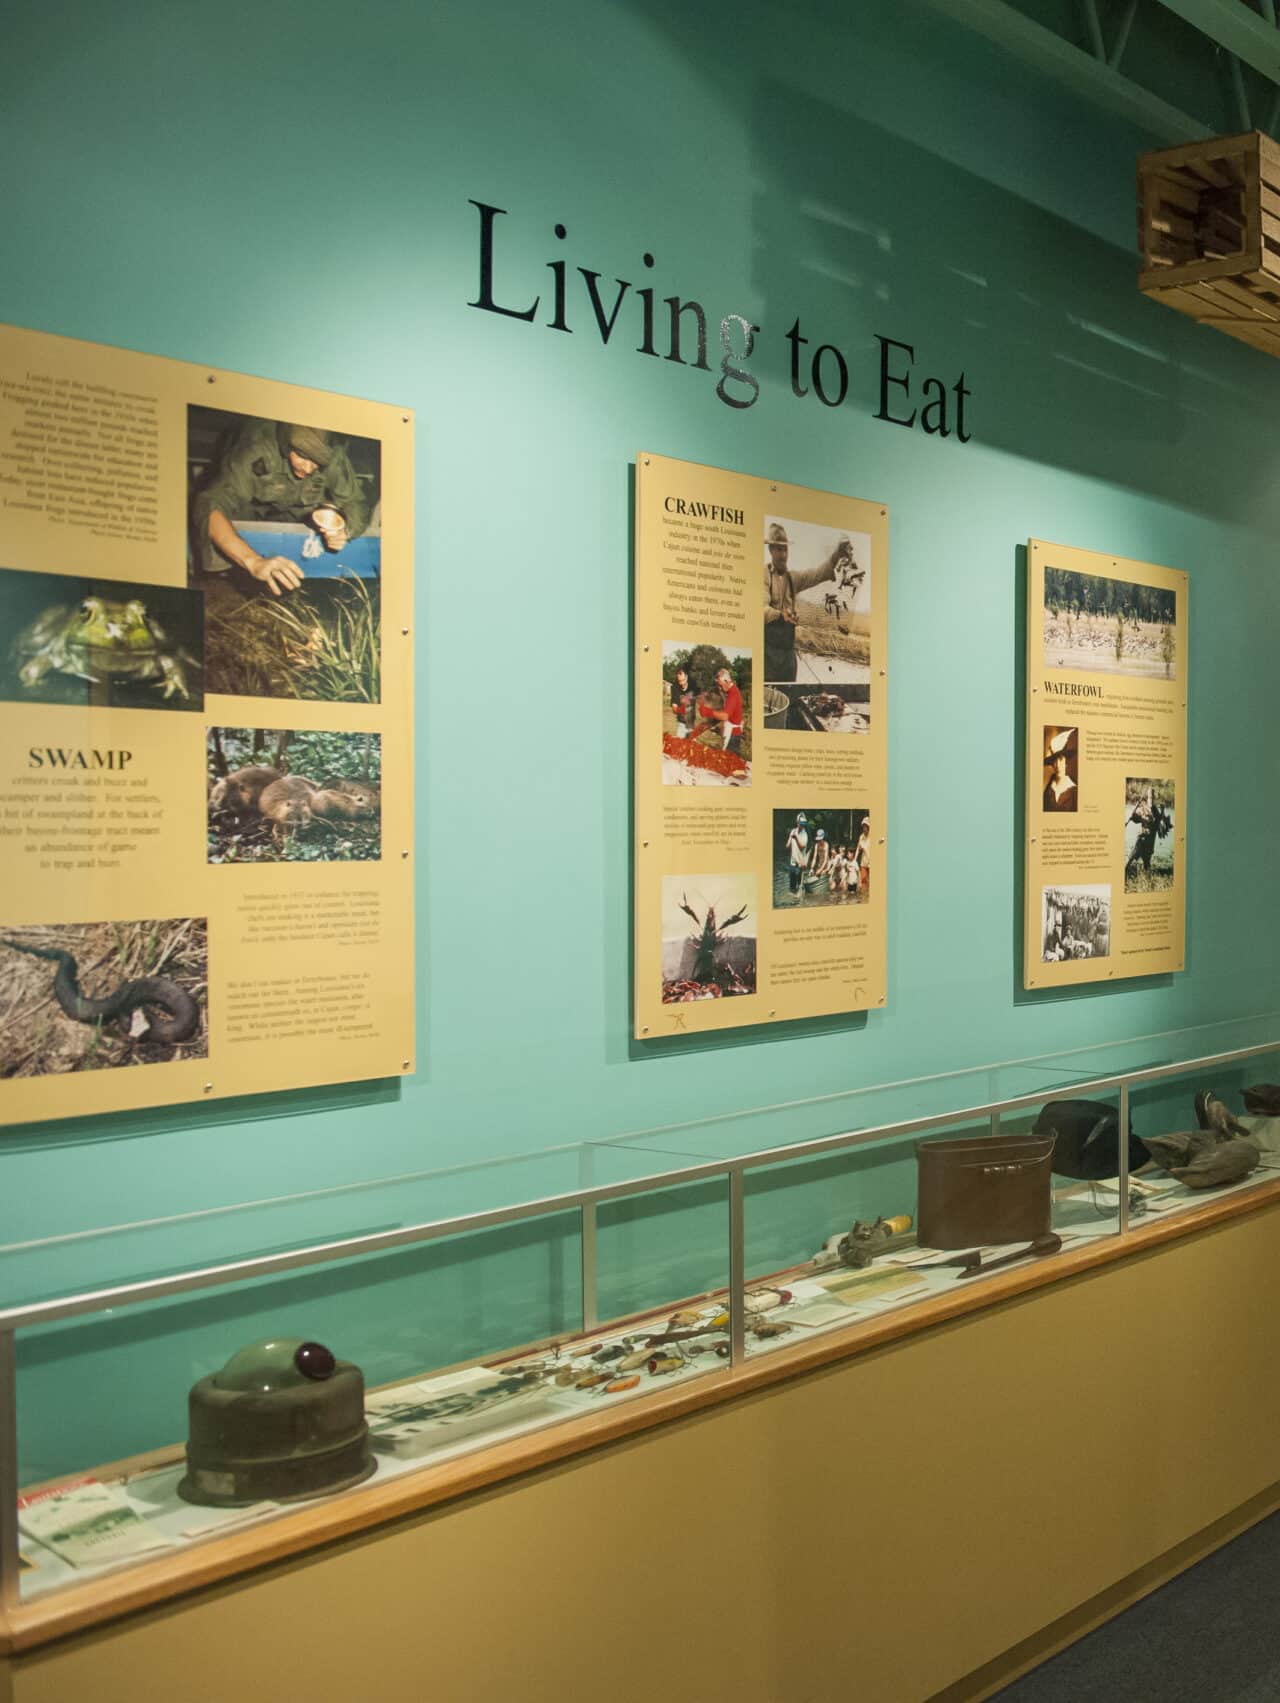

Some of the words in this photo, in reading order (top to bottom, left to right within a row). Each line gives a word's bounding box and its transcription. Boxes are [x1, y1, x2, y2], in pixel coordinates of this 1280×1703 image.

[467, 199, 760, 409] Living
[785, 316, 849, 407] to
[871, 334, 972, 443] Eat
[664, 496, 744, 525] CRAWFISH
[1043, 681, 1104, 698] WATERFOWL
[28, 747, 133, 770] SWAMP
